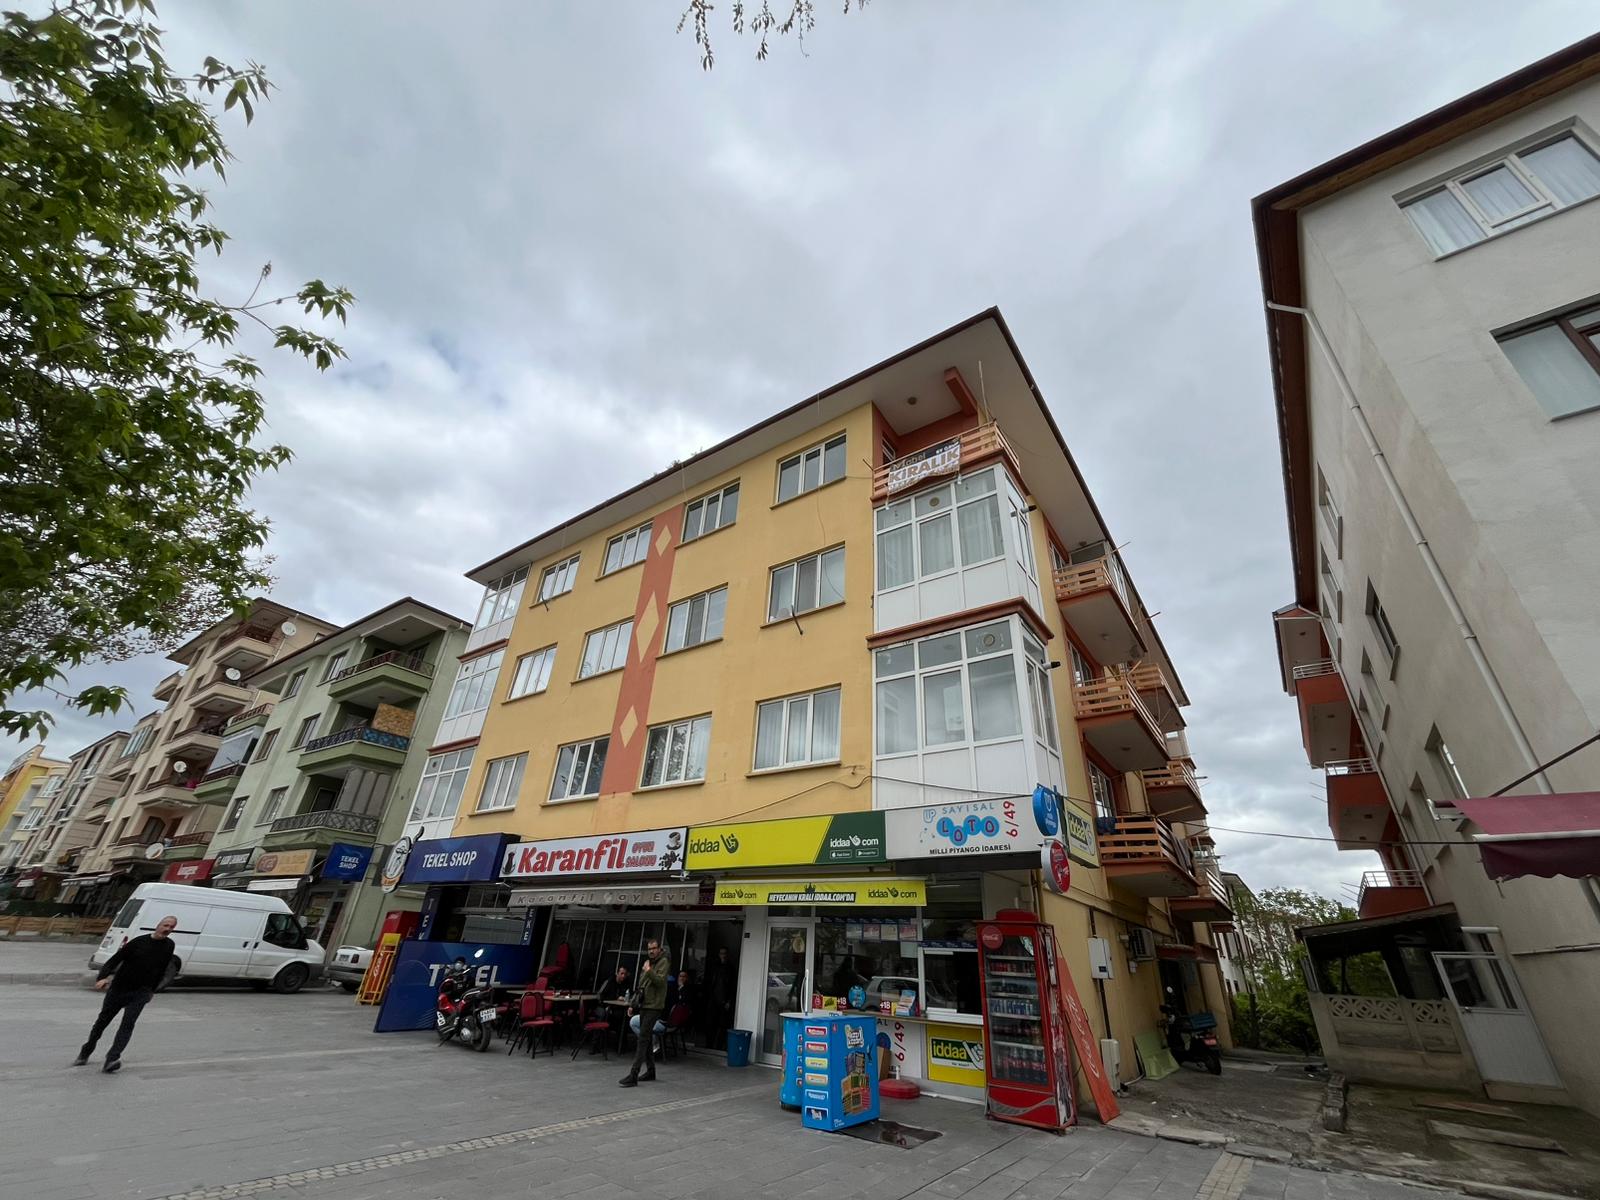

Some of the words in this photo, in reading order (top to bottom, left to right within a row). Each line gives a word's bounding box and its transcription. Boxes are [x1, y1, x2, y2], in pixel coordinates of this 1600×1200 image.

[943, 803, 994, 814] SAYISAL
[1003, 801, 1019, 837] 6/49
[942, 819, 994, 841] LOTO
[517, 838, 629, 873] Karanfil
[689, 839, 720, 854] iddaa
[341, 856, 359, 864] TEKEL
[422, 853, 449, 868] TEKEL
[450, 850, 478, 866] SHOP
[626, 855, 657, 868] SALONU
[518, 893, 594, 904] Karanfil
[653, 892, 687, 902] Evi
[428, 964, 501, 987] TEL
[837, 997, 846, 1005] +18
[894, 1022, 906, 1062] 6/49
[933, 1041, 967, 1060] iddaa
